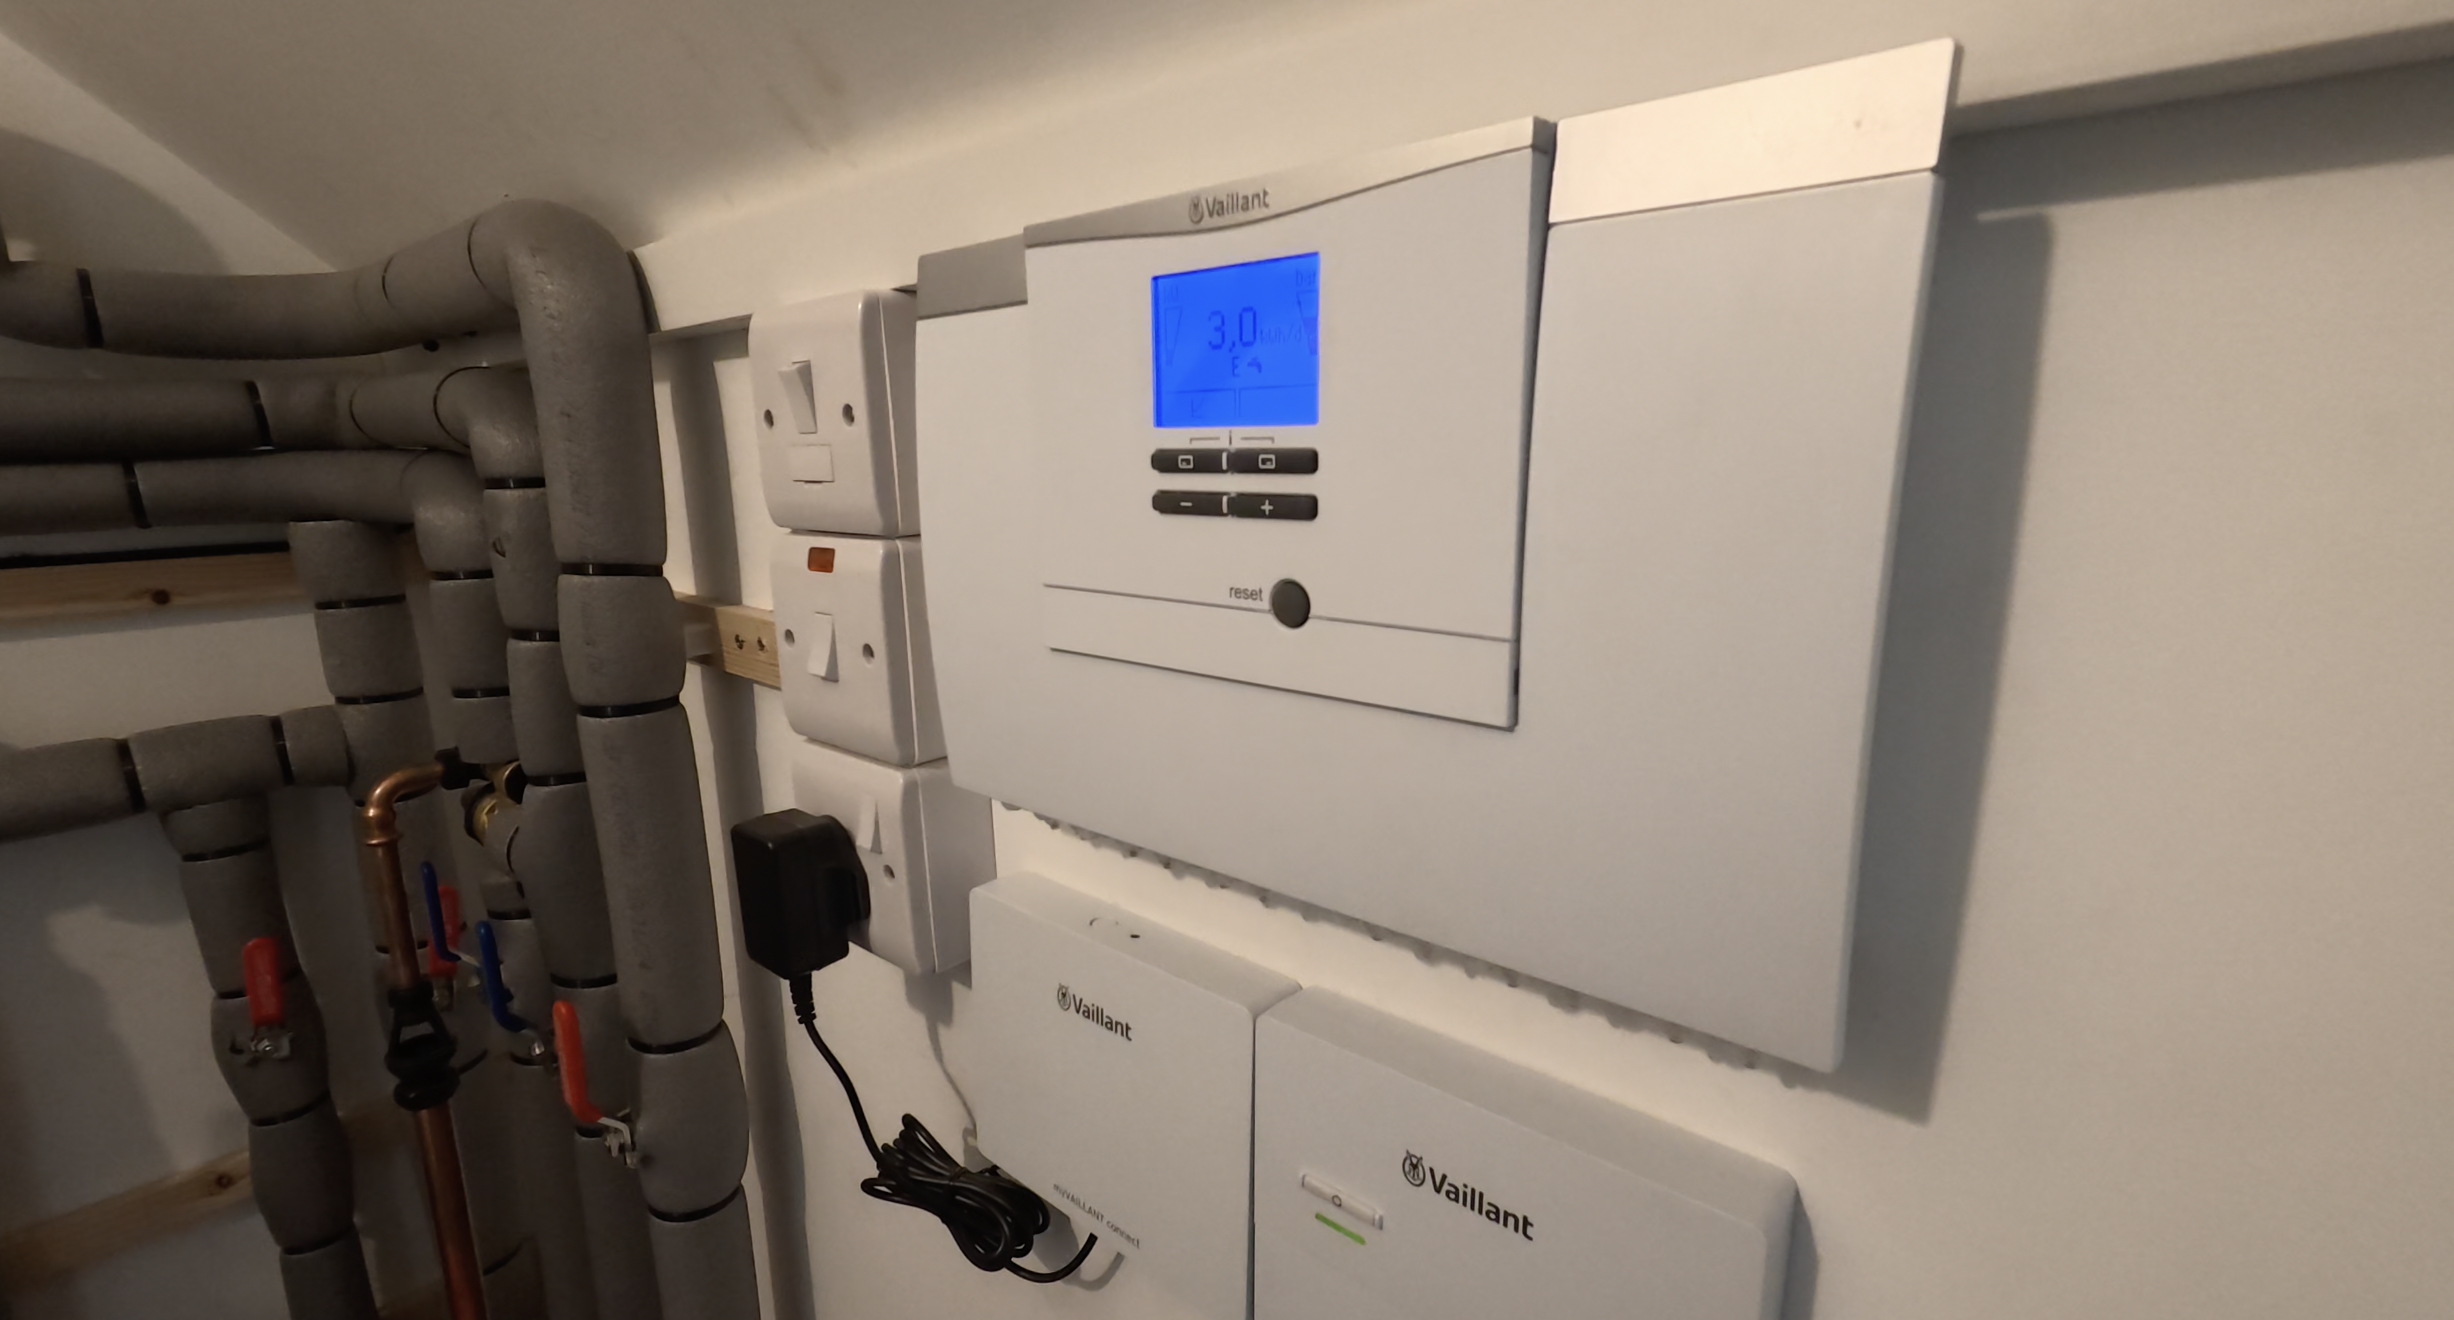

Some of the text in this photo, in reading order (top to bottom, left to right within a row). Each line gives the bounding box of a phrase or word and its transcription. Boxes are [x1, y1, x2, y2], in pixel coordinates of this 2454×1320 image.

[1205, 188, 1270, 220] Vaillant
[1229, 586, 1263, 602] reset
[1073, 994, 1132, 1041] Vaillant
[1429, 1166, 1534, 1241] Vaillant
[1106, 1221, 1140, 1249] connect
